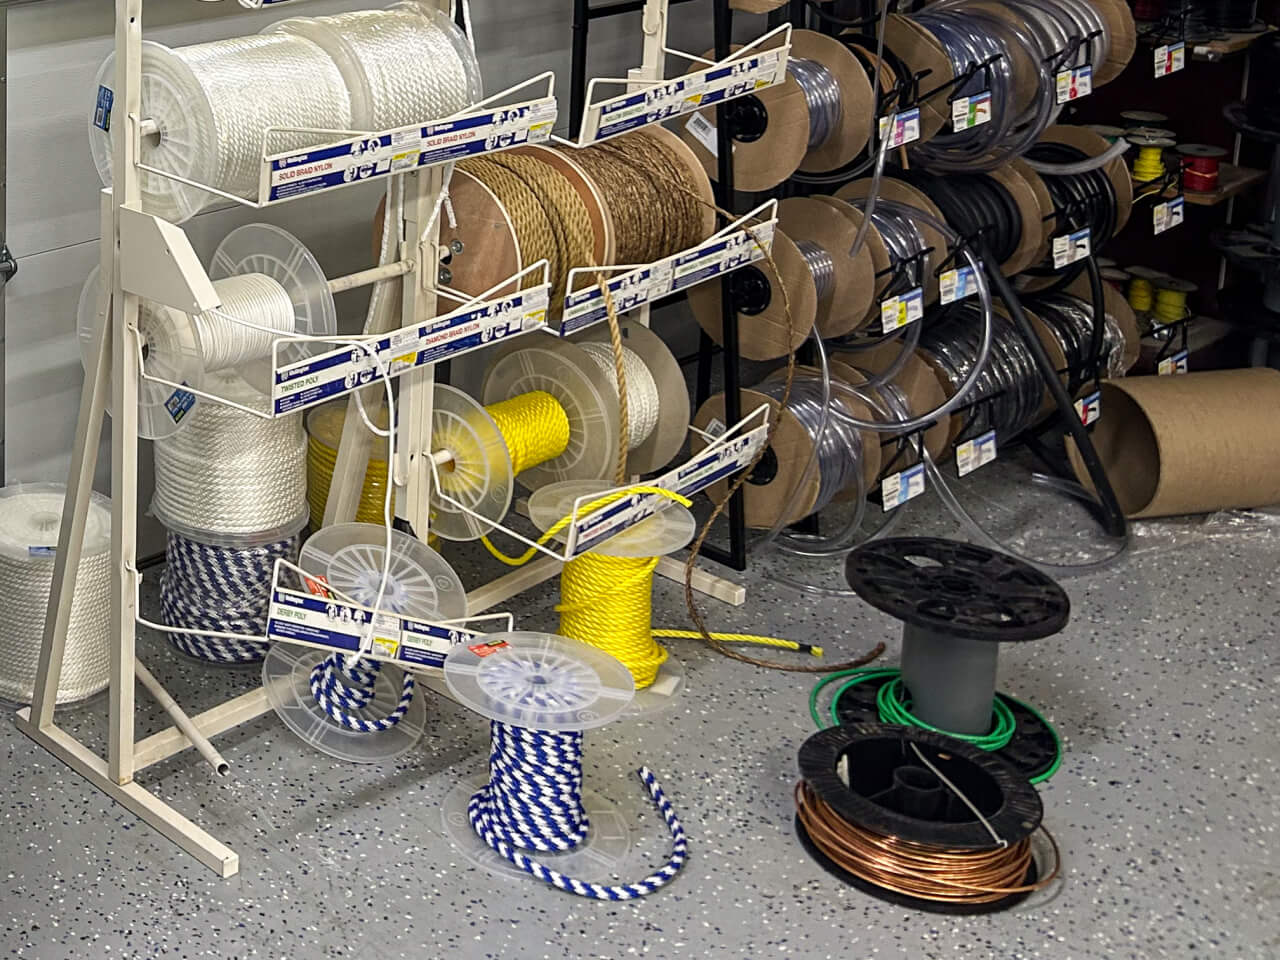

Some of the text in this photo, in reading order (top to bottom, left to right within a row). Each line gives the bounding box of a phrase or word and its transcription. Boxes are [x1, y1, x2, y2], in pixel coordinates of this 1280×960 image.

[278, 162, 333, 182] SOLID BRAID NYLON
[463, 323, 481, 335] NYLON
[281, 375, 319, 393] TWISTED POLY
